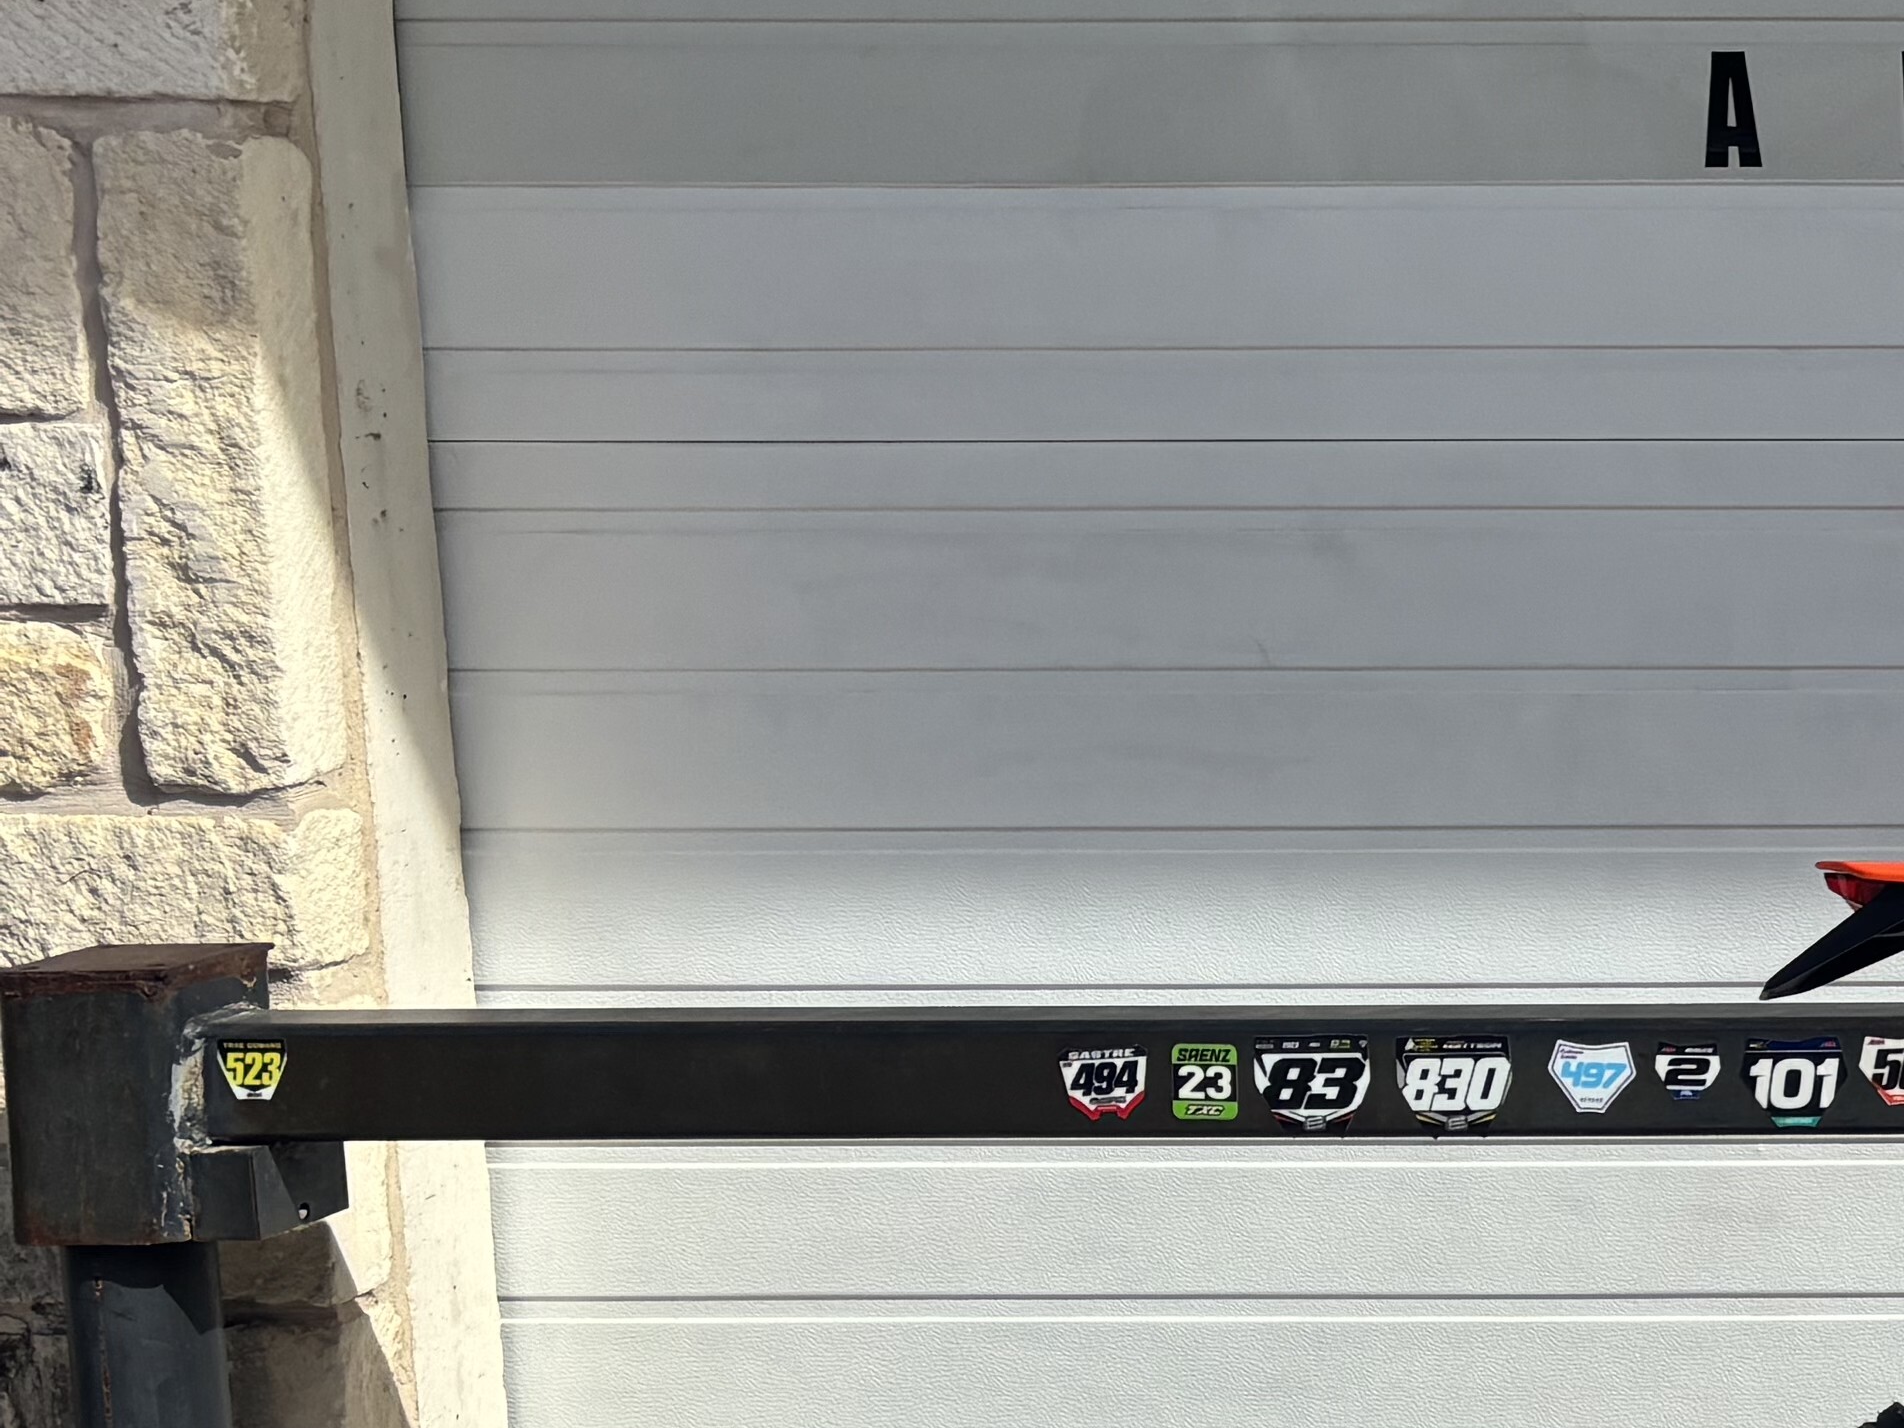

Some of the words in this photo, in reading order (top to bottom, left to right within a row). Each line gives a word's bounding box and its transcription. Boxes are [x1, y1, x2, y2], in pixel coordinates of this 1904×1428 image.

[226, 1052, 281, 1086] 523
[1177, 1048, 1231, 1063] SAENZ
[1664, 1057, 1710, 1087] 2
[1070, 1060, 1139, 1097] 494
[1178, 1065, 1232, 1100] 23
[1262, 1057, 1366, 1110] 83
[1402, 1057, 1511, 1111] 830
[1561, 1060, 1627, 1089] 497
[1749, 1057, 1840, 1110] 101
